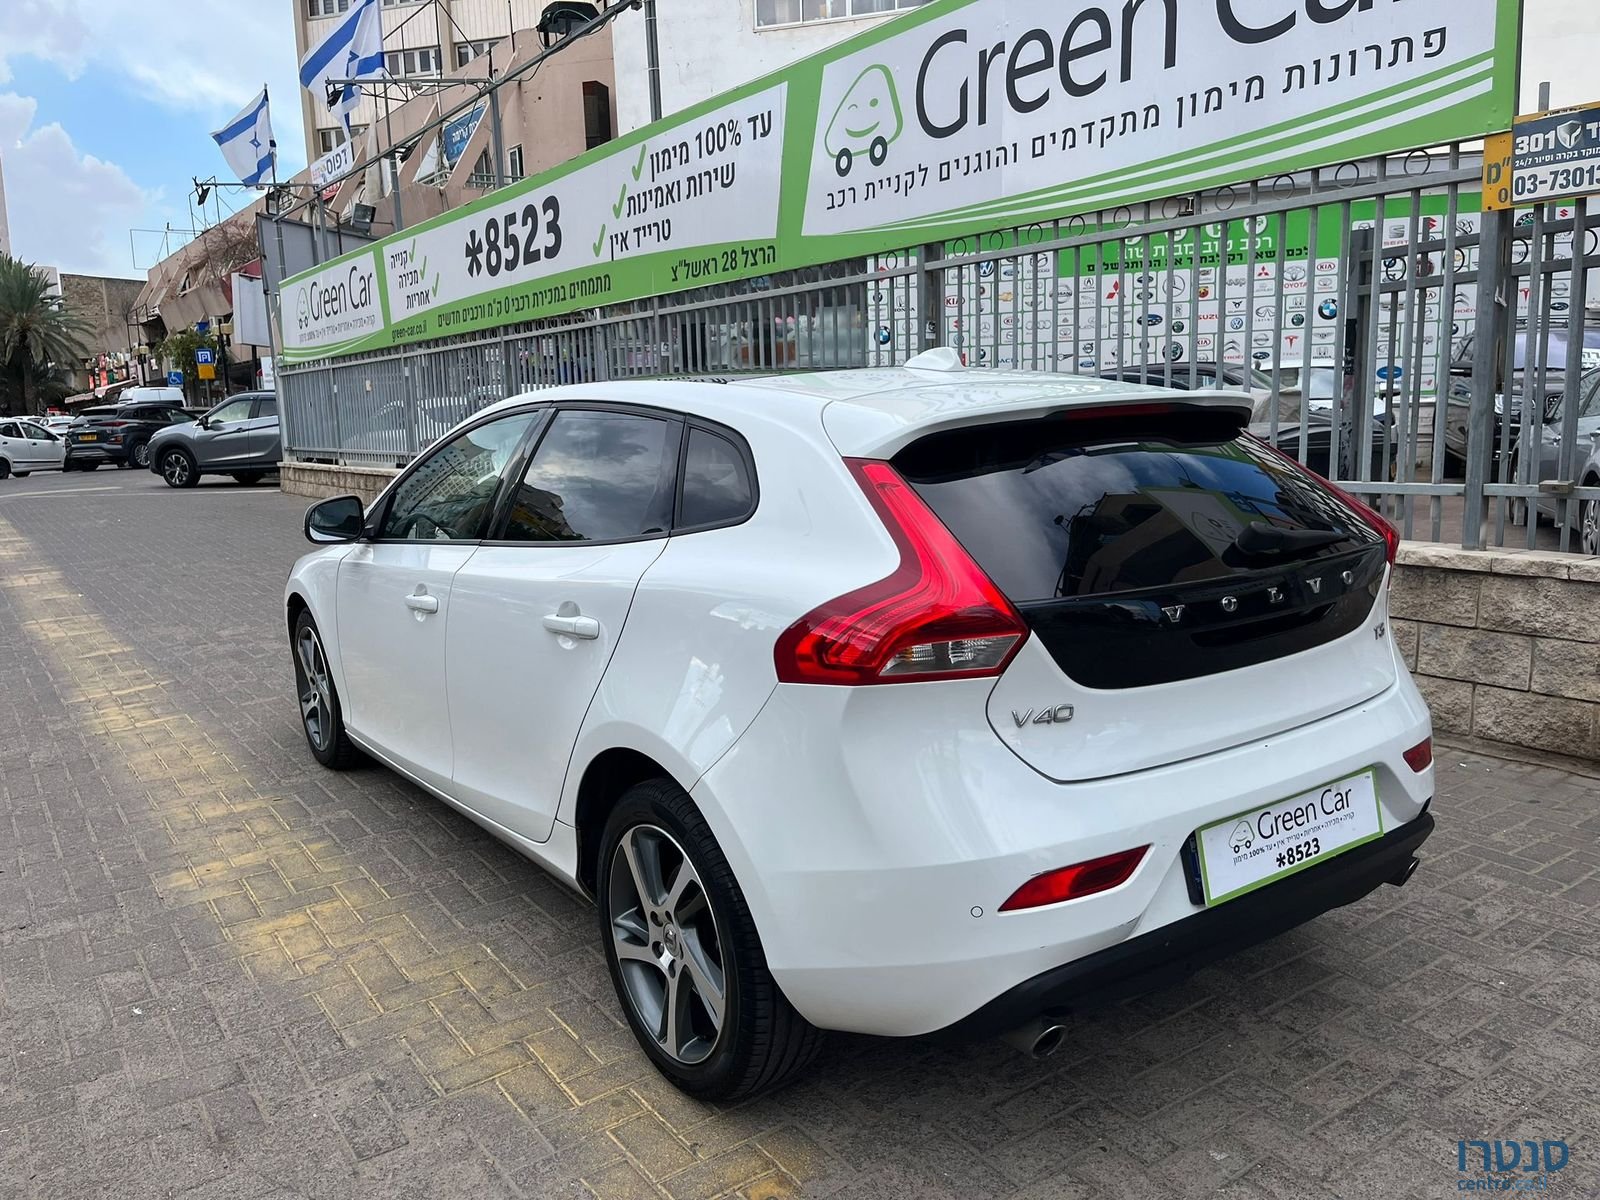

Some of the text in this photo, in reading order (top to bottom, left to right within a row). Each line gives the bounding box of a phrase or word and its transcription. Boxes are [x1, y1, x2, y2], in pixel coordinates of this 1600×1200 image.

[916, 0, 1177, 139] Green
[826, 26, 1447, 211] פתרונות מימון מתקדמים והוגנים לקניית רכב
[649, 110, 772, 183] עד 100% מימון
[1514, 130, 1556, 156] 301
[326, 149, 347, 175] דפוס
[1514, 157, 1532, 168] 24/7
[1534, 154, 1554, 164] וסיור
[1555, 150, 1578, 161] בקרה
[626, 162, 736, 218] שירות ואמינות
[609, 218, 672, 262] טרייד אין
[390, 250, 408, 270] קנייה
[721, 248, 738, 273] 28
[741, 244, 776, 269] הרצל
[398, 269, 419, 289] מכירה
[569, 273, 612, 300] מתמחים
[1226, 278, 1246, 287] eep
[310, 265, 373, 321] Green Car
[406, 288, 431, 310] אחריות
[504, 295, 510, 315] 0
[511, 294, 530, 313] רכבי
[532, 285, 567, 309] במכירת
[437, 310, 461, 328] חדשים
[462, 304, 486, 323] ורכבים
[391, 320, 428, 343] green-car.co.il
[1161, 570, 1354, 623] VOLVO
[1011, 703, 1074, 728] V40
[1257, 788, 1352, 840] Green Car
[1249, 847, 1265, 858] 100%
